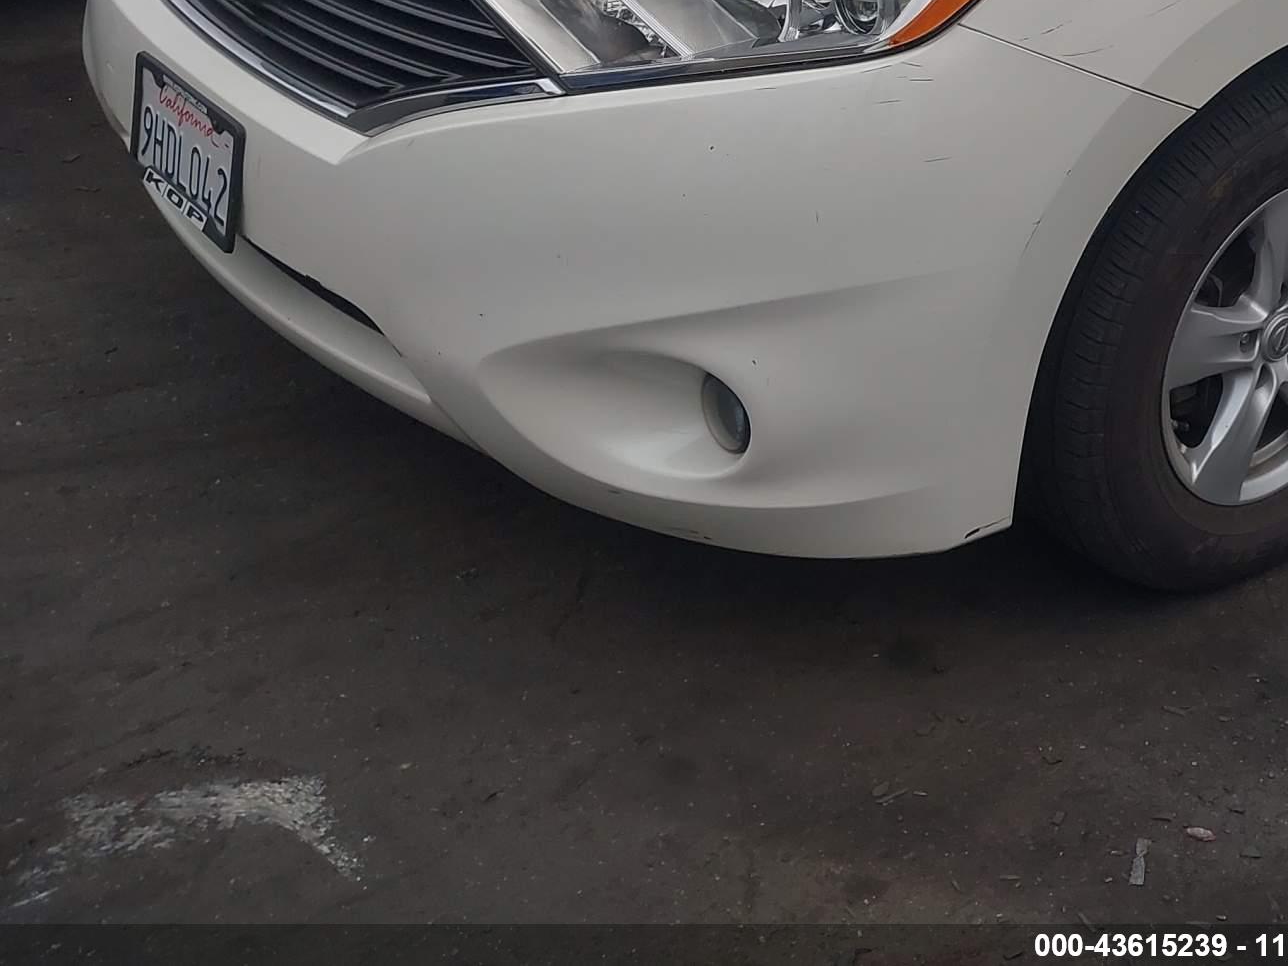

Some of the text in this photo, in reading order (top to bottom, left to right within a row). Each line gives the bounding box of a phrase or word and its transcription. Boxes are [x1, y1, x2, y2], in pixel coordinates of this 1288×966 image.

[159, 84, 217, 143] California
[142, 106, 228, 226] 9HDL042
[145, 170, 205, 224] KOP
